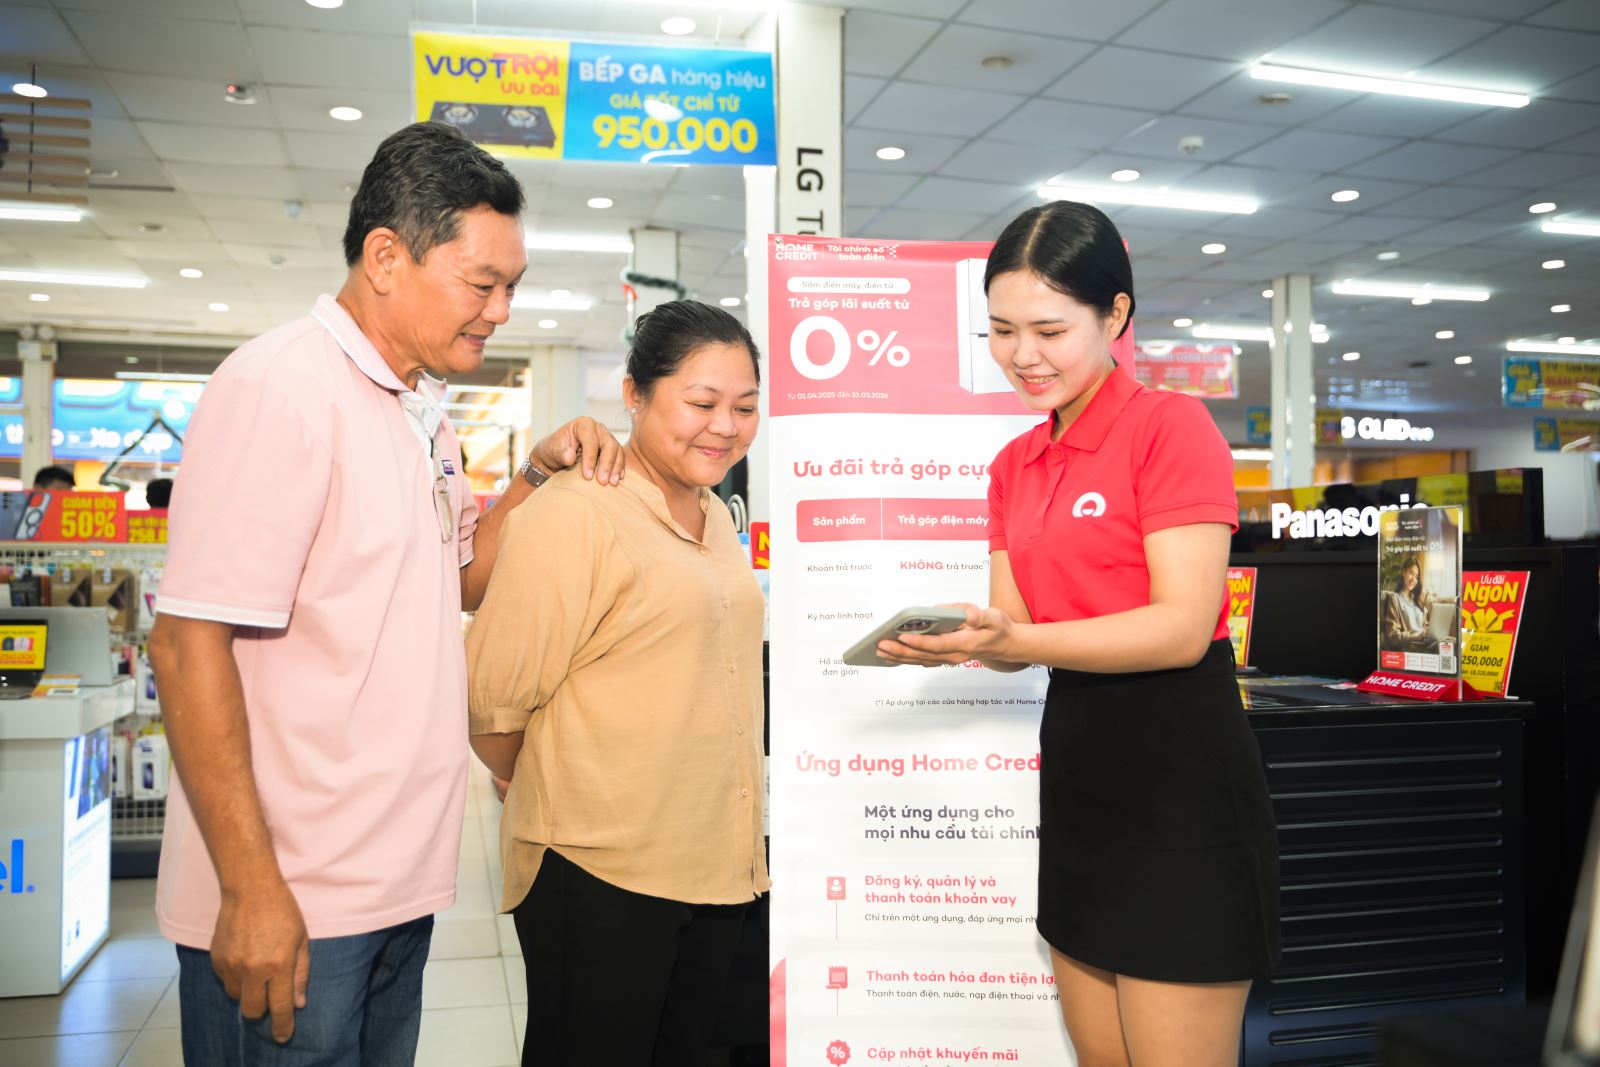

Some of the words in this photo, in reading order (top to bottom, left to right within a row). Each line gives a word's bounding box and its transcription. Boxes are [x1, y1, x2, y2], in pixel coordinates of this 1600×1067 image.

[578, 54, 624, 82] BẾP
[628, 63, 668, 84] GA
[671, 68, 721, 90] hàng
[726, 69, 766, 91] hiệu
[609, 91, 641, 108] GIÁ
[684, 92, 714, 110] CHỈ
[717, 93, 740, 112] TỪ
[592, 113, 758, 153] 950.000
[797, 148, 823, 191] LG
[797, 210, 823, 235] T
[775, 243, 815, 252] HOME
[826, 244, 842, 252] Tài
[844, 244, 871, 252] chính
[775, 252, 818, 261] CREDIT
[838, 252, 862, 261] toàn
[864, 253, 886, 262] diện
[788, 297, 810, 309] Trả
[814, 299, 838, 311] góp
[842, 298, 858, 309] lãi
[861, 297, 892, 309] suất
[793, 460, 822, 477] Ưu
[829, 458, 863, 476] đãi
[870, 457, 904, 475] trả
[910, 459, 951, 481] góp
[61, 510, 116, 538] 50%
[812, 516, 835, 526] Sản
[836, 514, 866, 527] phẩm
[897, 514, 915, 524] Trả
[918, 515, 938, 527] góp
[940, 515, 963, 527] điện
[966, 515, 989, 527] máy
[1271, 493, 1428, 539] Panaso
[900, 559, 944, 570] KHÔNG
[946, 562, 959, 570] trả
[1492, 574, 1506, 585] đãi
[1463, 581, 1519, 608] NgoN
[837, 612, 852, 620] linh
[1366, 676, 1404, 688] HOME
[1401, 680, 1446, 692] CREDIT
[957, 698, 975, 706] hàng
[796, 750, 841, 777] Ứng
[848, 754, 905, 777] dụng
[912, 754, 978, 771] Home
[864, 805, 897, 821] Một
[901, 805, 933, 822] ứng
[937, 805, 979, 822] dụng
[984, 805, 1015, 818] cho
[865, 825, 895, 842] mọi
[900, 826, 930, 839] nhu
[935, 824, 966, 839] cầu
[970, 825, 994, 839] tài
[864, 874, 901, 888] Đăng
[926, 874, 961, 889] quản
[964, 875, 975, 889] lý
[980, 876, 996, 887] và
[865, 892, 905, 903] thanh
[909, 892, 941, 903] toán
[945, 891, 988, 904] khoản
[992, 895, 1017, 907] vay
[882, 913, 900, 921] trên
[968, 914, 985, 924] đáp
[1006, 915, 1023, 923] mọi
[866, 971, 909, 982] Thanh
[913, 971, 945, 982] toán
[949, 971, 975, 983] hóa
[979, 971, 1005, 983] đơn
[1009, 972, 1037, 986] tiện
[1041, 973, 1056, 987] lợ
[866, 989, 894, 998] Thanh
[896, 989, 917, 998] toán
[969, 991, 986, 1001] nạp
[988, 991, 1008, 1000] điện
[1010, 991, 1034, 1001] thoại
[1037, 992, 1048, 1000] và
[867, 1047, 896, 1062] Cập
[900, 1047, 932, 1061] nhật
[936, 1046, 988, 1062] khuyến
[992, 1048, 1019, 1060] mãi
